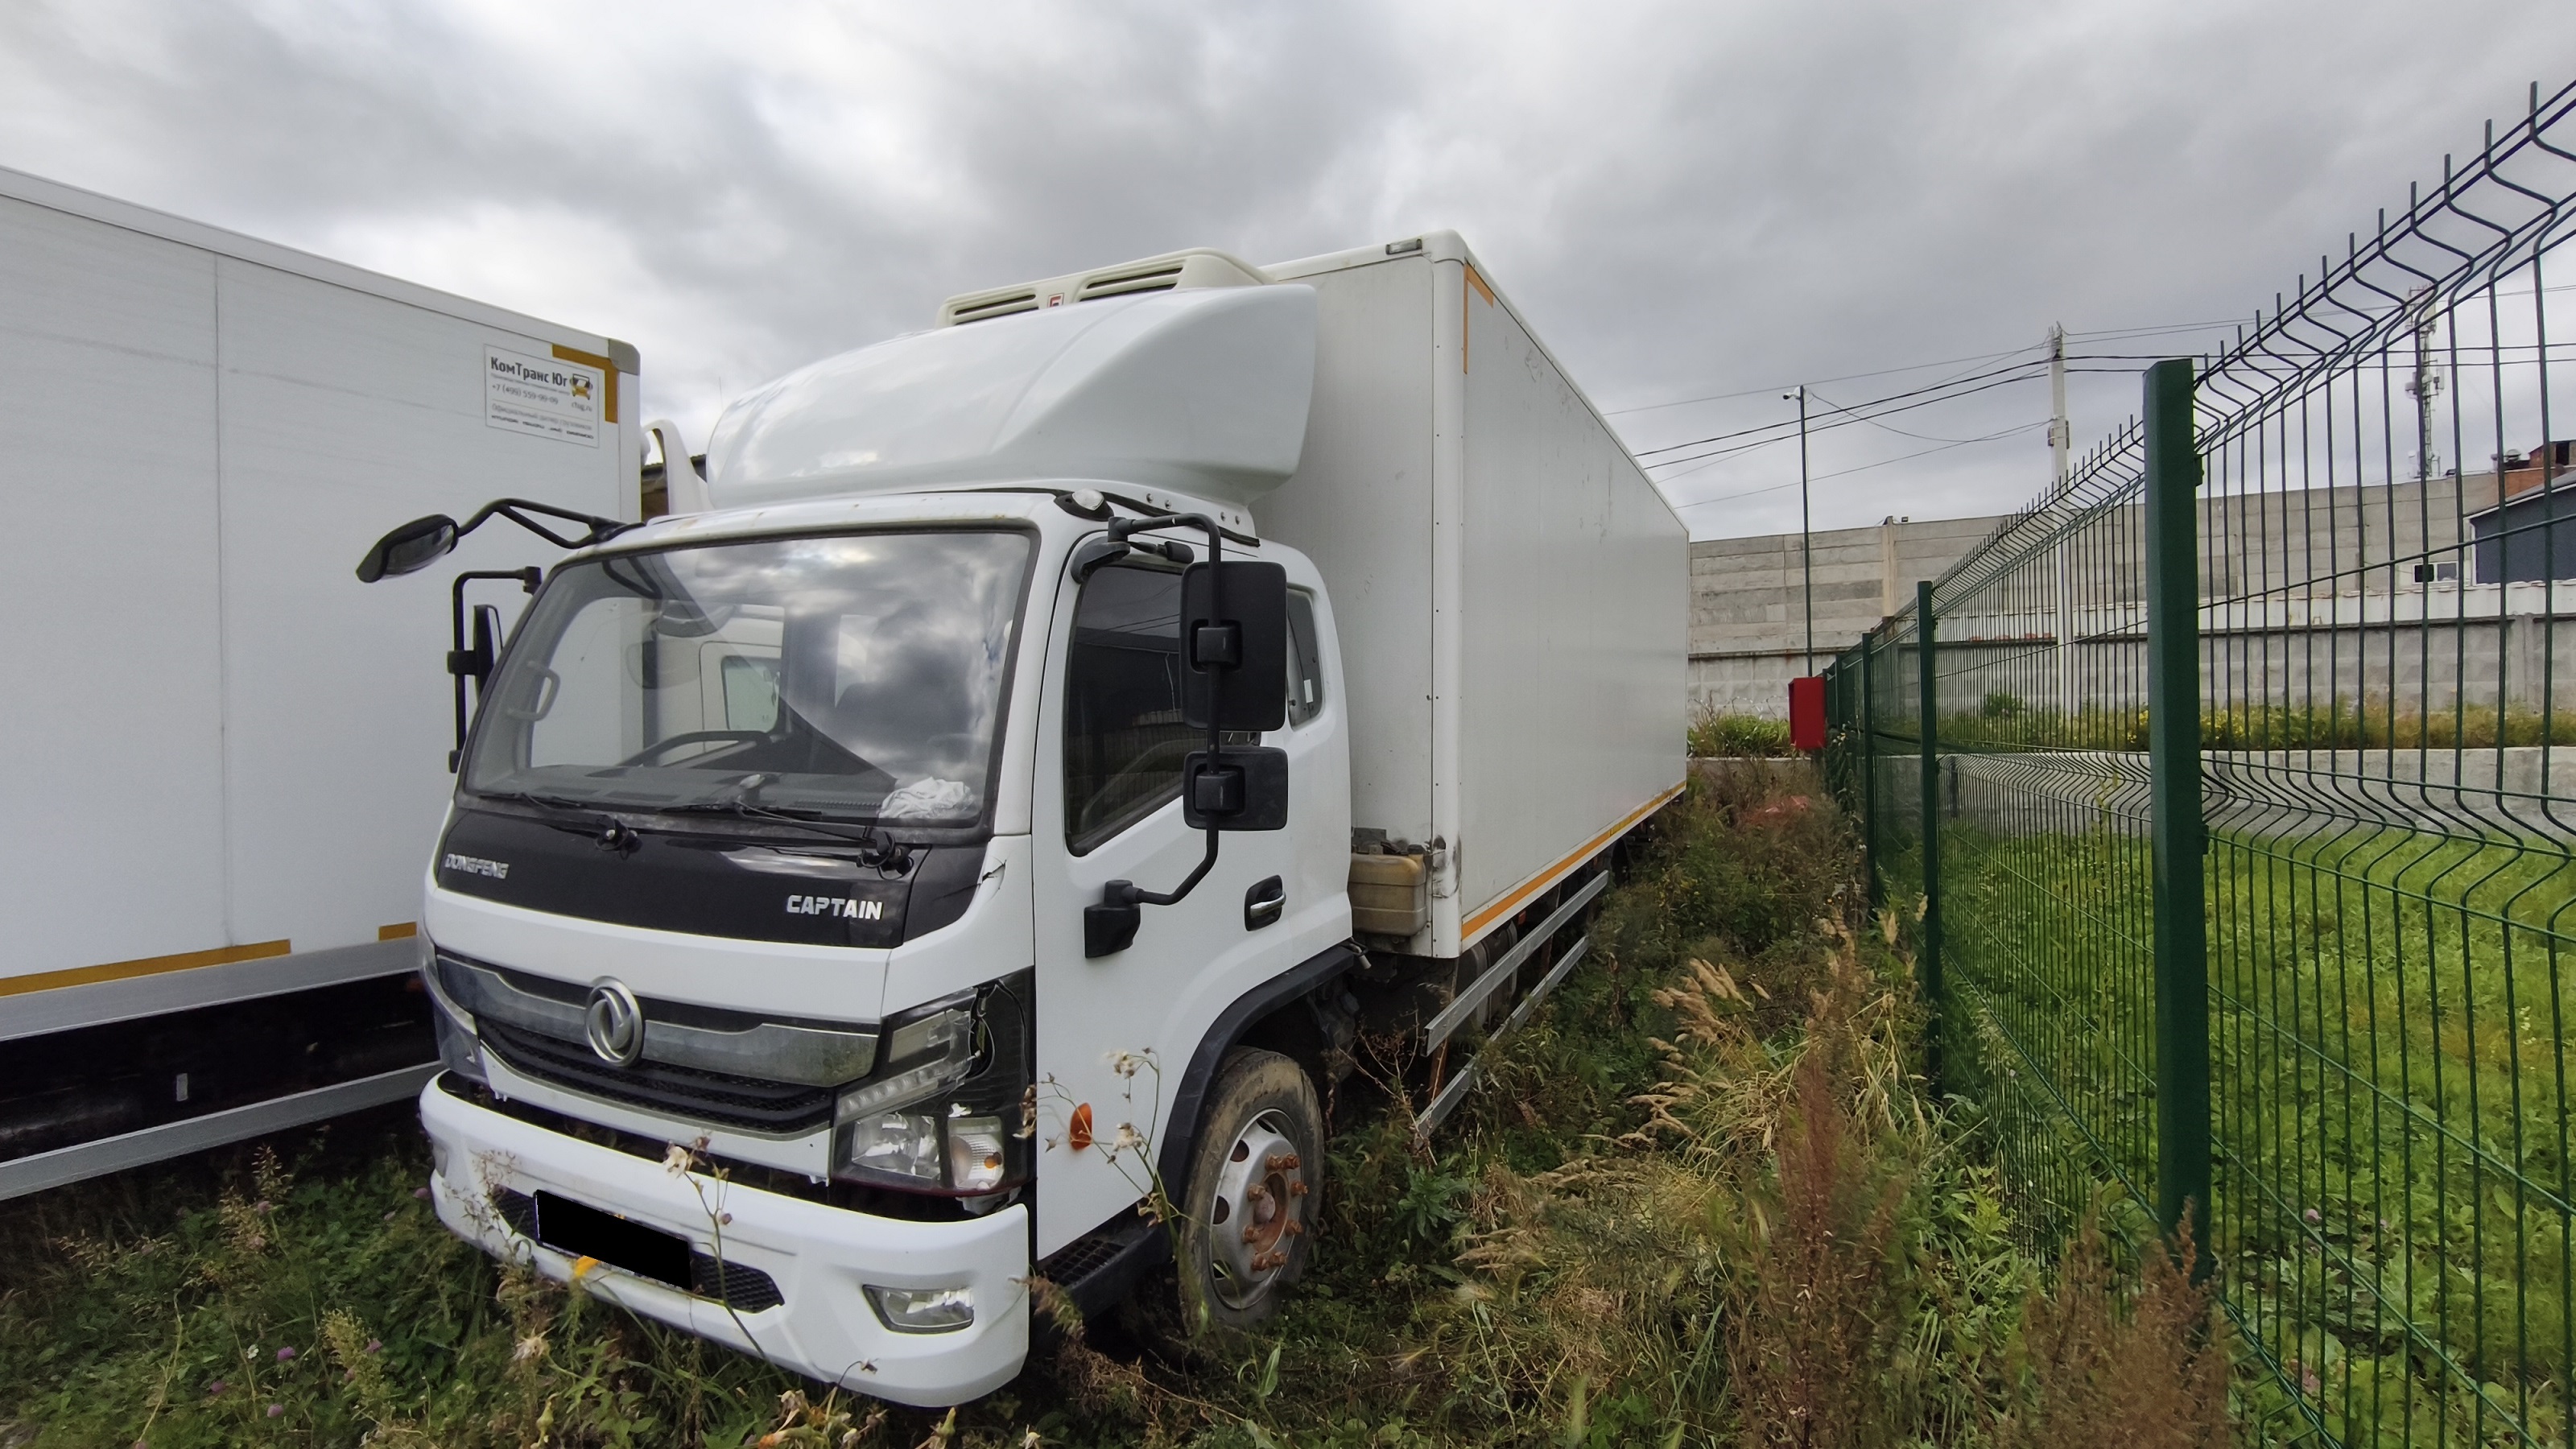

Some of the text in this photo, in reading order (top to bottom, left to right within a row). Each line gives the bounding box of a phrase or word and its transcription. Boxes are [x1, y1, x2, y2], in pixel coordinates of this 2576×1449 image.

[491, 357, 549, 382] КомТранс
[552, 372, 568, 387] Юг
[444, 853, 510, 879] DONGFENG
[786, 894, 883, 920] CAPTAIN
